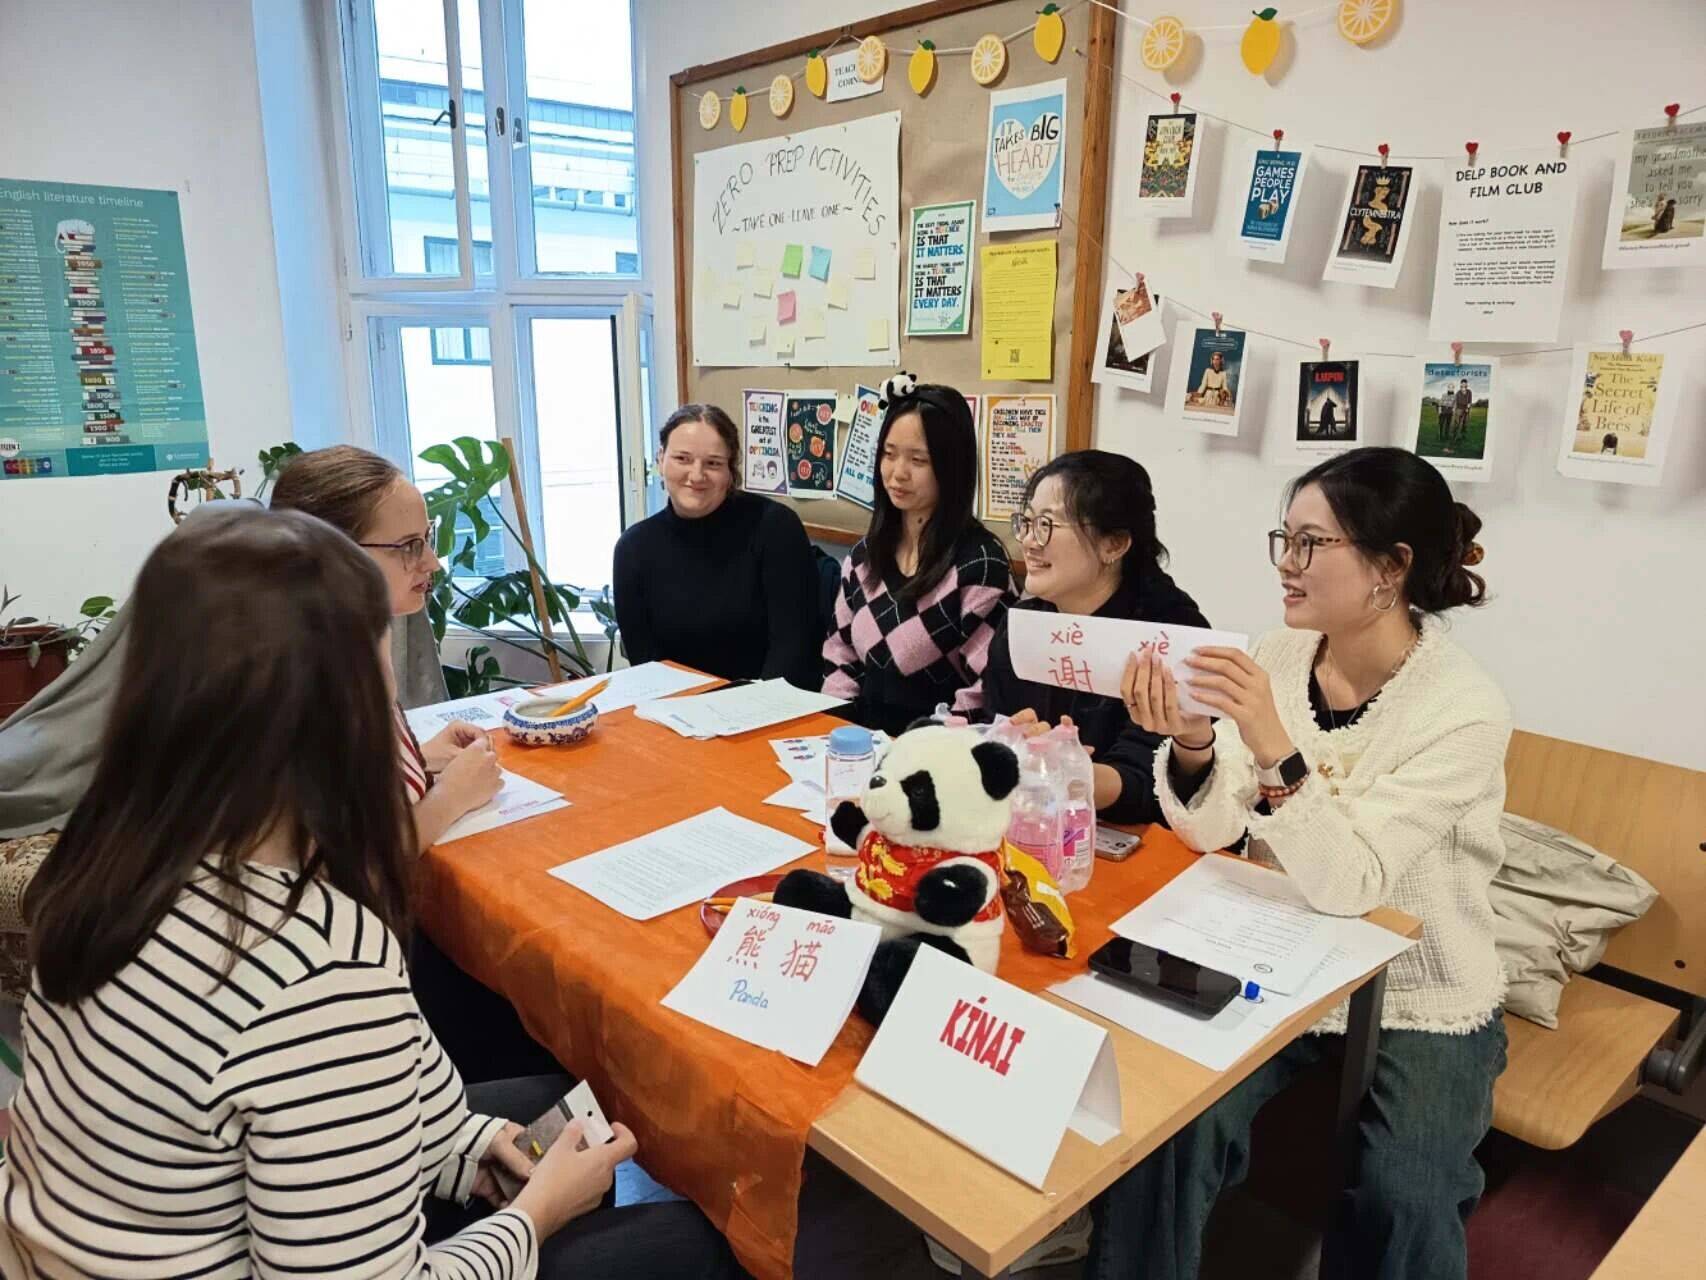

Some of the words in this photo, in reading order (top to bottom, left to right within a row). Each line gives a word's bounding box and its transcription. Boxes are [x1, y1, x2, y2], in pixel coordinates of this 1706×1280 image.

[1001, 120, 1014, 136] IT
[1030, 114, 1059, 141] BIG
[994, 129, 1024, 153] TAKES
[994, 142, 1060, 176] HEART
[1652, 145, 1706, 163] grandmothe
[1256, 165, 1295, 179] GAMES
[1456, 168, 1486, 182] DELP
[1489, 164, 1529, 178] BOOK
[1534, 161, 1568, 175] AND
[712, 162, 753, 235] ZERO
[768, 145, 804, 176] PREP
[809, 145, 886, 235] ACTIVITIES
[1253, 178, 1292, 190] PEOPLE
[1469, 186, 1501, 199] FILM
[1506, 182, 1544, 195] CLUB
[44, 191, 96, 205] literature
[98, 195, 144, 208] timeline
[1250, 187, 1290, 205] PLAY
[917, 236, 926, 247] IS
[928, 234, 949, 246] THAT
[916, 247, 926, 258] IT
[914, 277, 925, 288] IS
[926, 275, 947, 286] THAT
[914, 287, 924, 298] IT
[926, 285, 962, 298] MATTERS
[913, 297, 940, 309] EVERY
[1314, 371, 1345, 383] LUPIN
[1428, 368, 1488, 377] detectorists
[1611, 373, 1634, 385] The
[1594, 382, 1644, 400] Secret
[1592, 399, 1621, 415] Life
[1625, 401, 1646, 417] of
[1595, 415, 1631, 433] Bees
[1050, 622, 1084, 646] xiè
[1137, 630, 1170, 655] xiè
[1047, 655, 1094, 693] 谢
[746, 905, 781, 931] xióng
[726, 925, 822, 983] 熊猫
[728, 978, 769, 1009] Panda
[939, 996, 1025, 1077] KÍNAI
